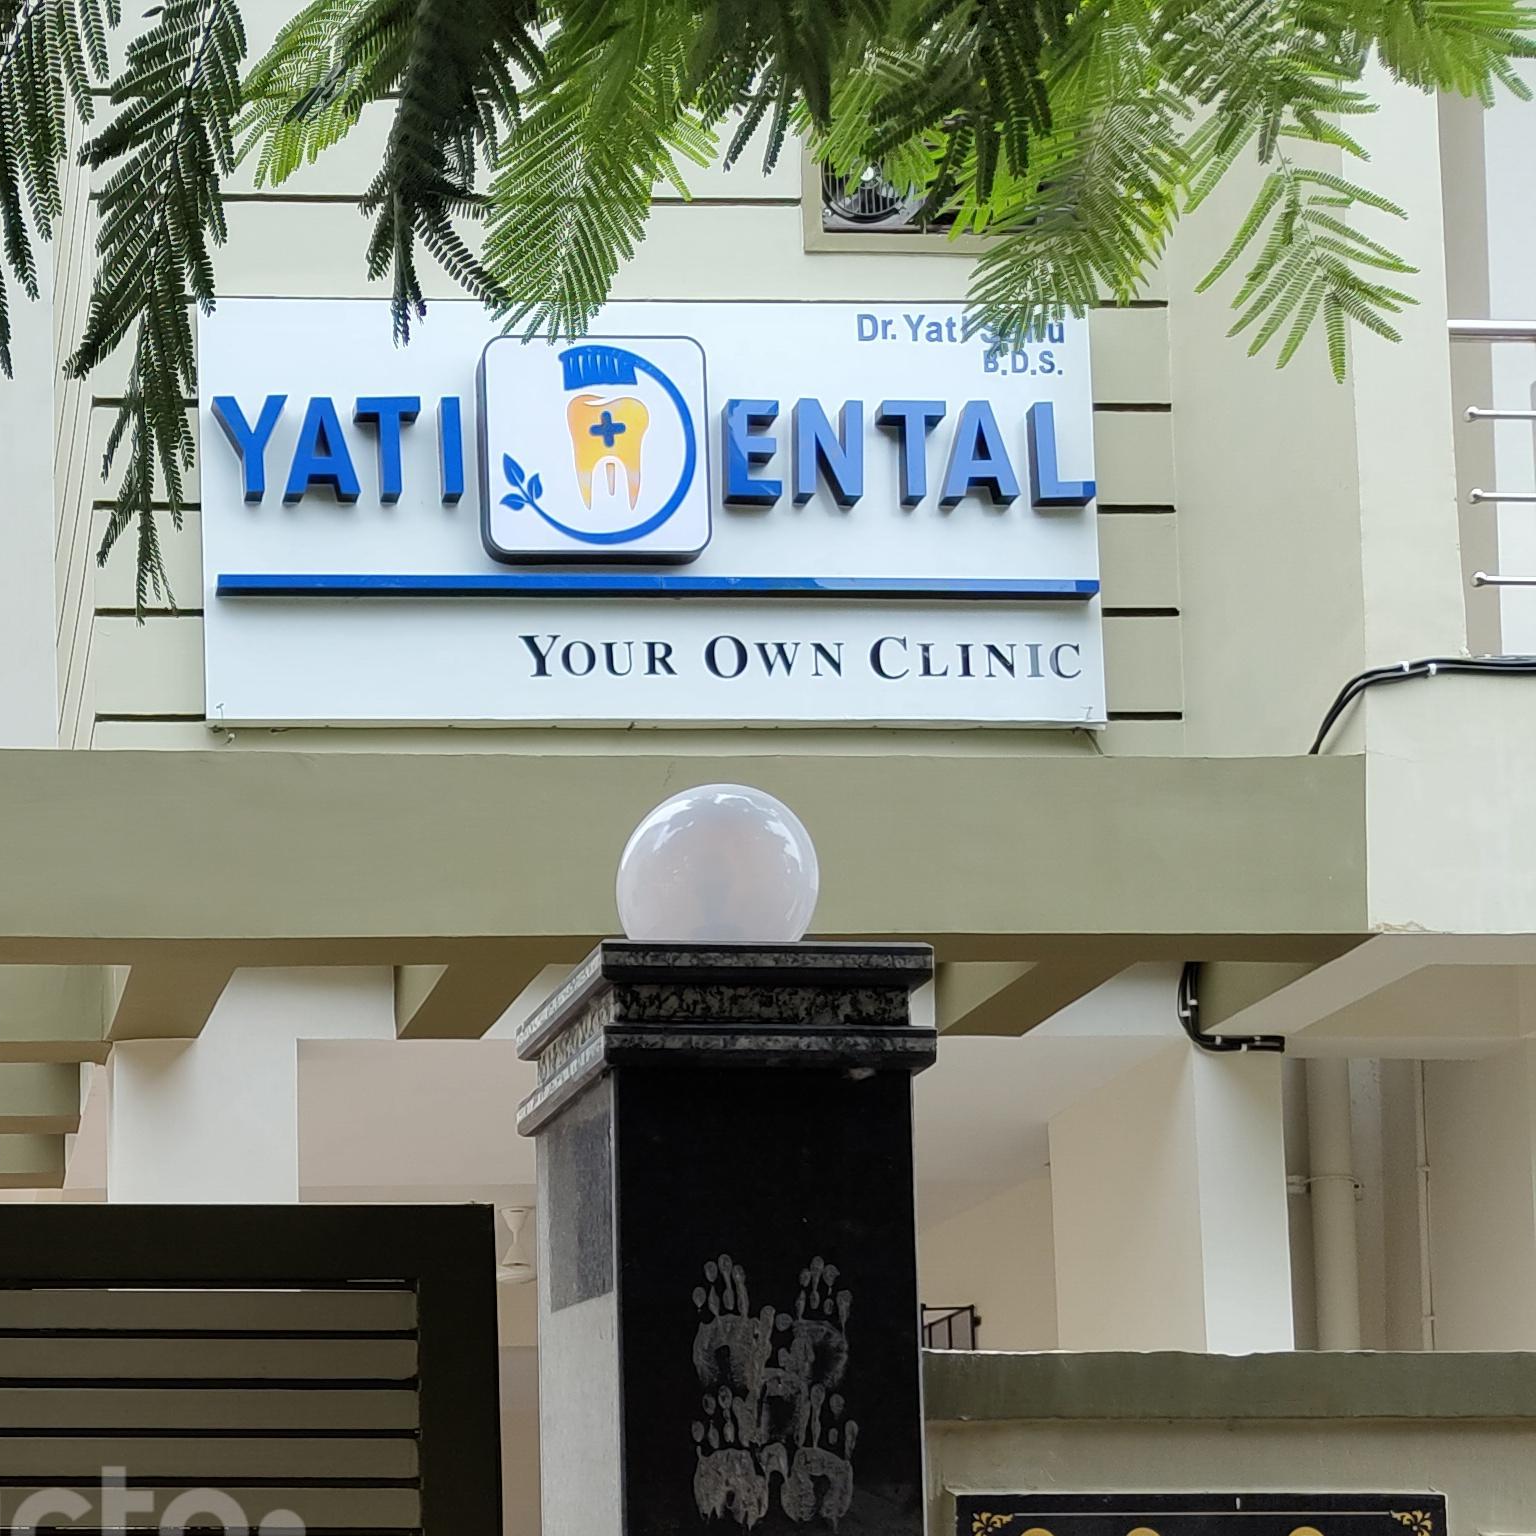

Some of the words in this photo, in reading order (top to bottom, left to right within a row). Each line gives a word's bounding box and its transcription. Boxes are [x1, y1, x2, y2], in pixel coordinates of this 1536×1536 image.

[983, 349, 1063, 376] B.D.S.
[210, 394, 464, 505] YATI
[720, 397, 1097, 508] ENTAL
[517, 634, 678, 679] YOUR
[704, 634, 844, 680] OWN
[869, 636, 1082, 680] CLINIC
